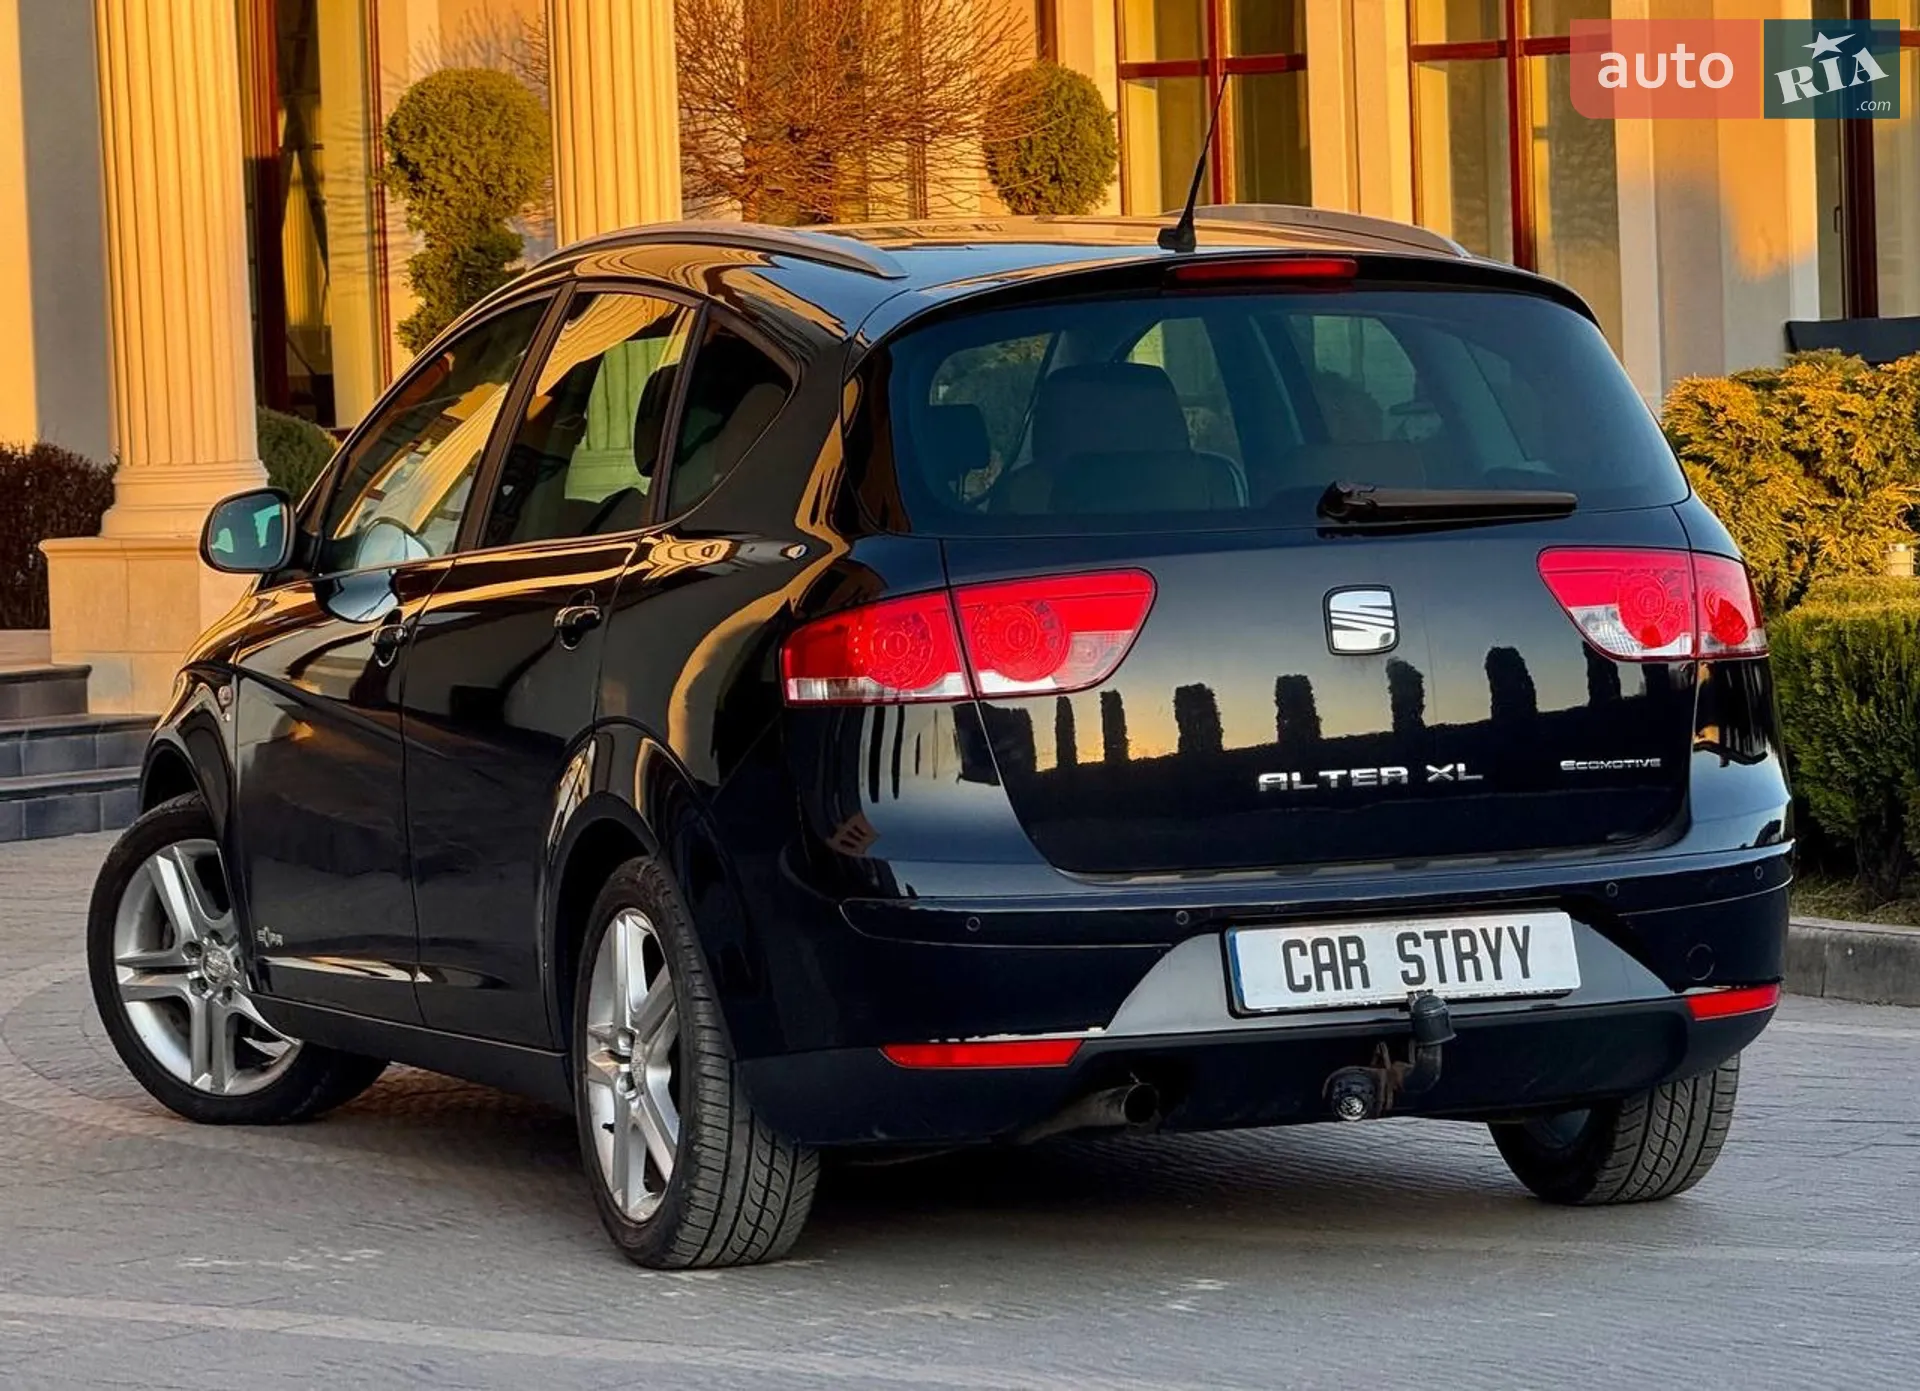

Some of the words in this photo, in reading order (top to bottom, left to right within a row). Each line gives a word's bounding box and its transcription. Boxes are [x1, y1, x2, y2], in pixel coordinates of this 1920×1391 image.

[1426, 763, 1484, 782] XL
[1282, 935, 1371, 993] CAR
[1396, 925, 1531, 987] STRYY
